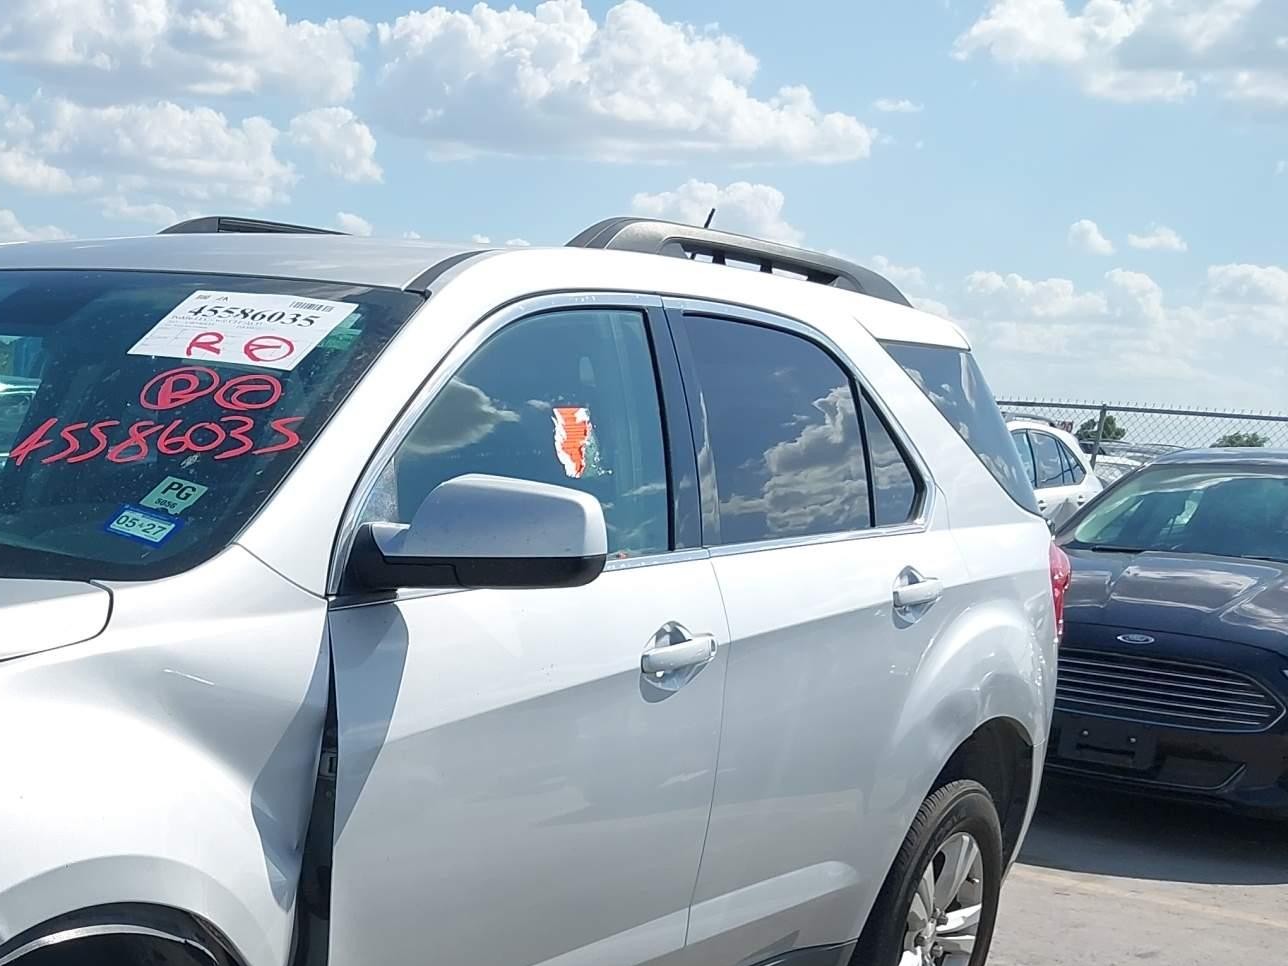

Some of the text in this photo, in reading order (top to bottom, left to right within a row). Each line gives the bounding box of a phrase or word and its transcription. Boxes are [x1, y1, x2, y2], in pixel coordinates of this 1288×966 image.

[187, 304, 321, 328] 45586035
[186, 332, 224, 356] R
[9, 415, 305, 466] 45586035
[161, 481, 196, 501] PG
